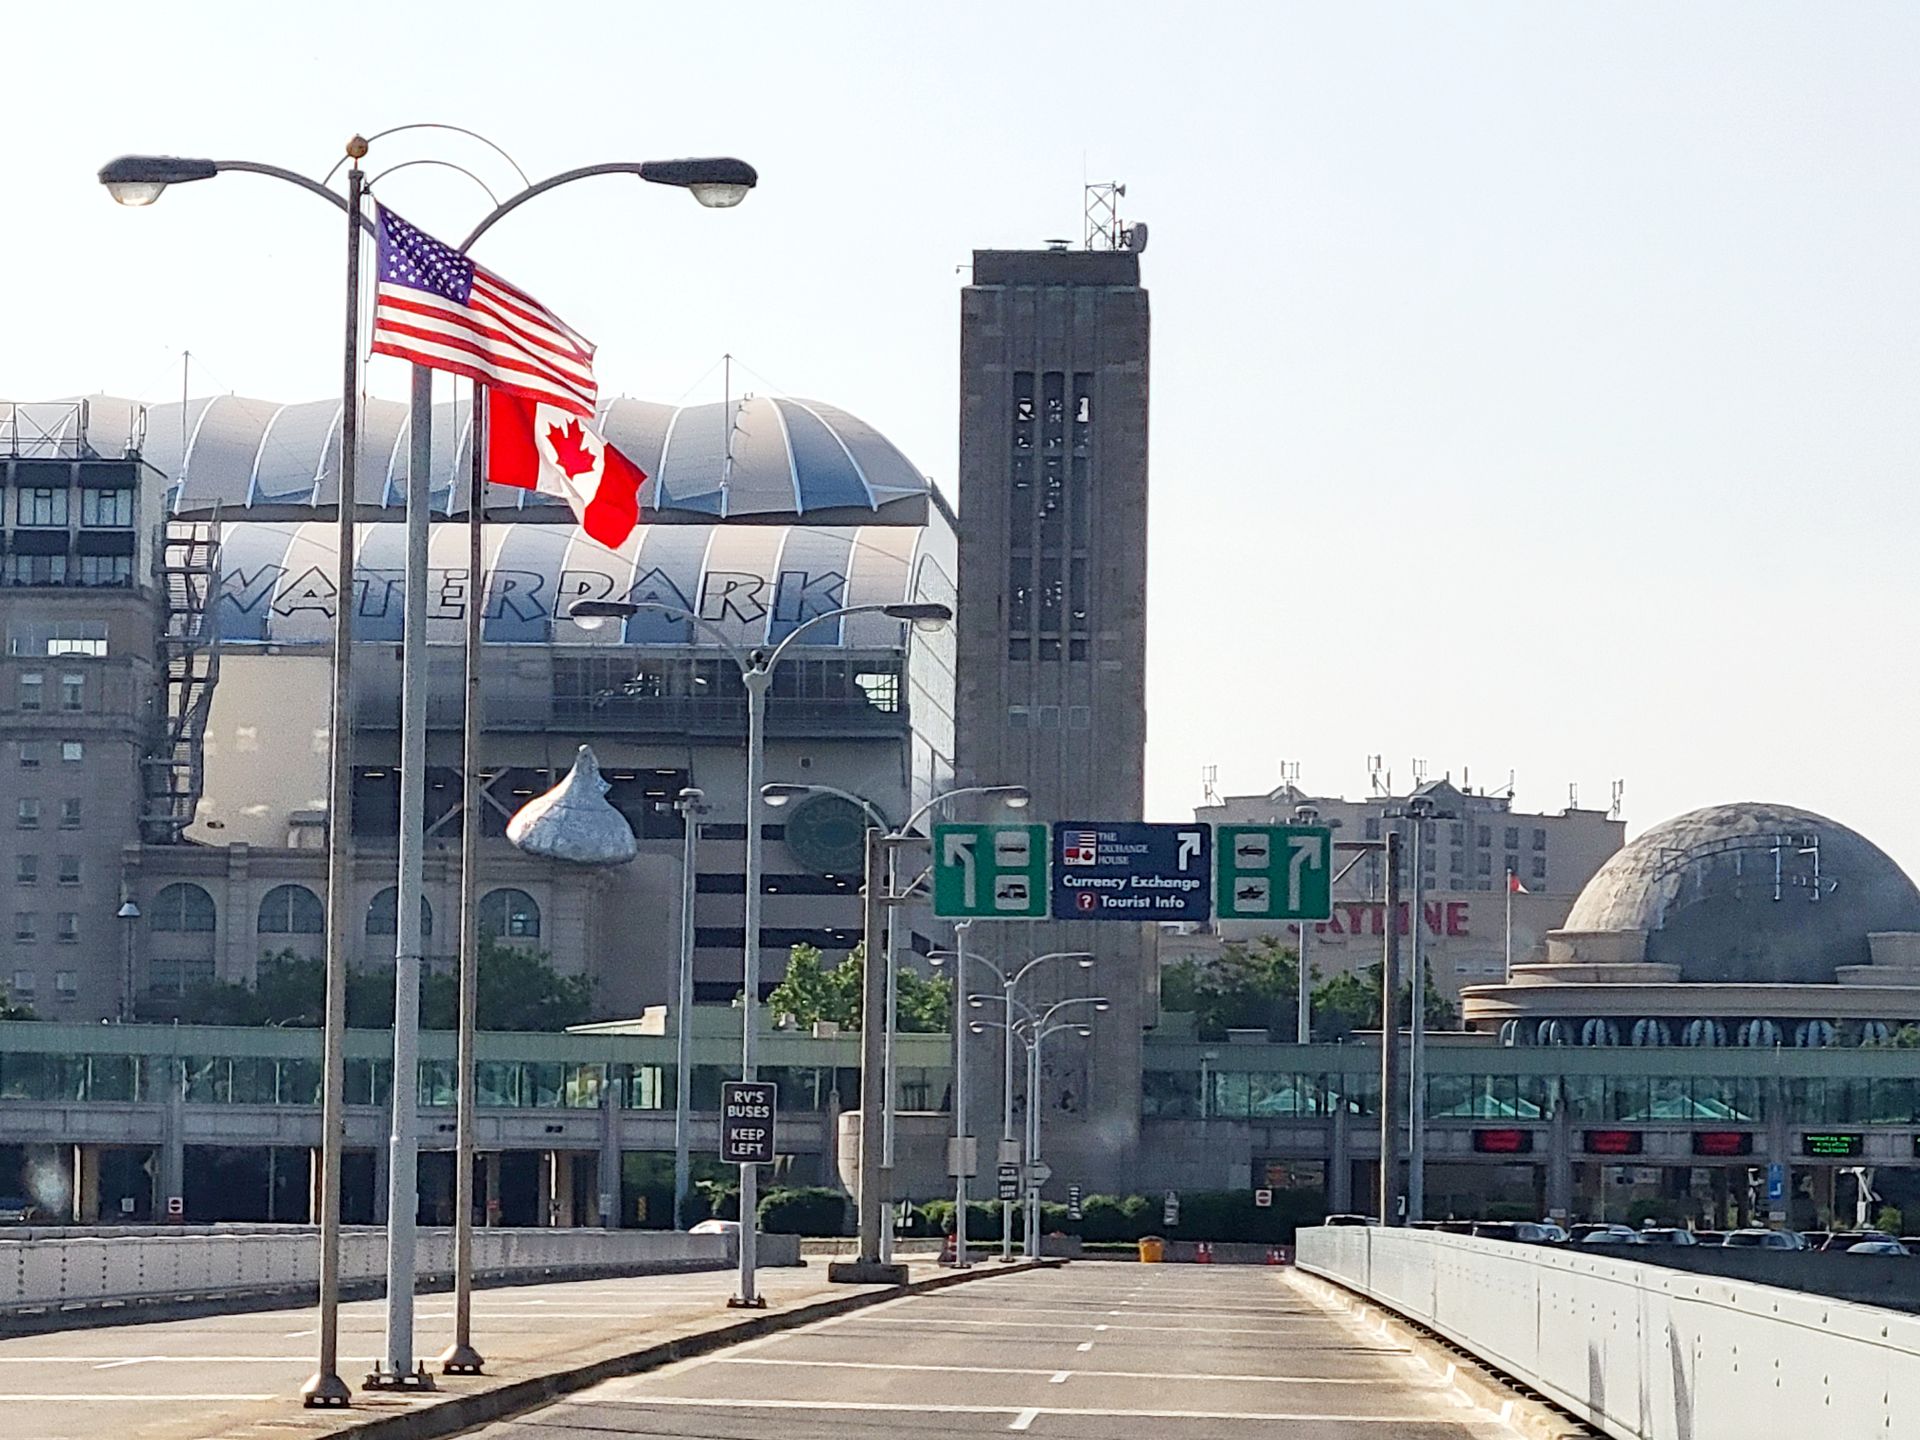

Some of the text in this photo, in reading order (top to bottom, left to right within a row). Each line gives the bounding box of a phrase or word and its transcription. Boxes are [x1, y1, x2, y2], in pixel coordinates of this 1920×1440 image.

[1098, 832, 1117, 842] THE
[1098, 844, 1149, 854] EXCHANGE
[1098, 855, 1129, 865] HOUSE
[1063, 875, 1200, 891] Currency Exchange
[1101, 895, 1150, 908] Tourist
[1155, 895, 1185, 908] Info
[734, 1091, 765, 1103] RV'S
[727, 1105, 770, 1118] BUSES
[731, 1128, 765, 1141] KEEP
[731, 1143, 763, 1155] LEFT
